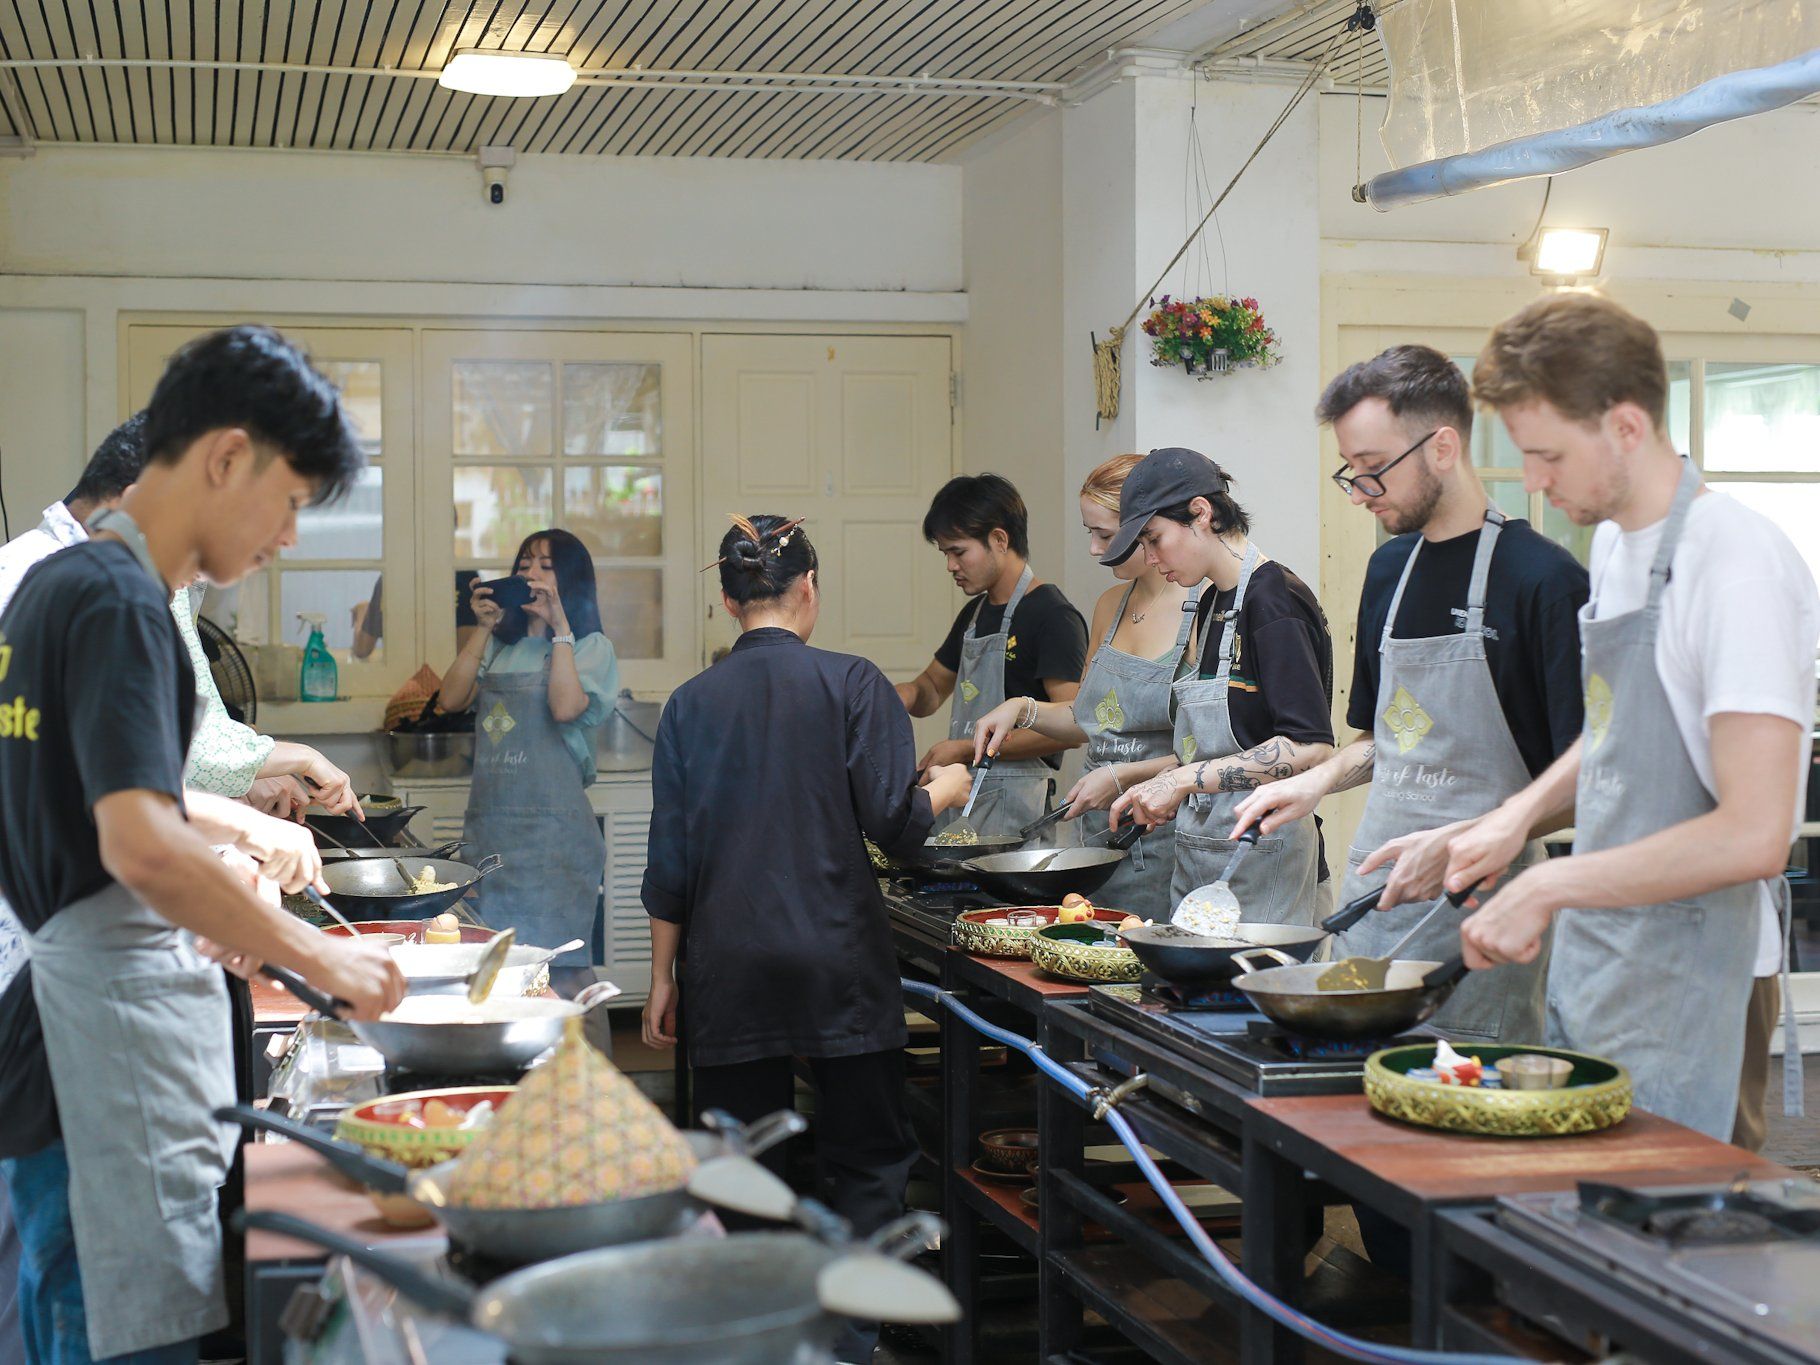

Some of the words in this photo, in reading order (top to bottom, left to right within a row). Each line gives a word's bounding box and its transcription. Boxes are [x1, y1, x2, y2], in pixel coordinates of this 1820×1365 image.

[1096, 740, 1109, 756] of
[1112, 737, 1145, 756] Taste
[1393, 764, 1411, 787] of
[1415, 763, 1458, 789] Taste
